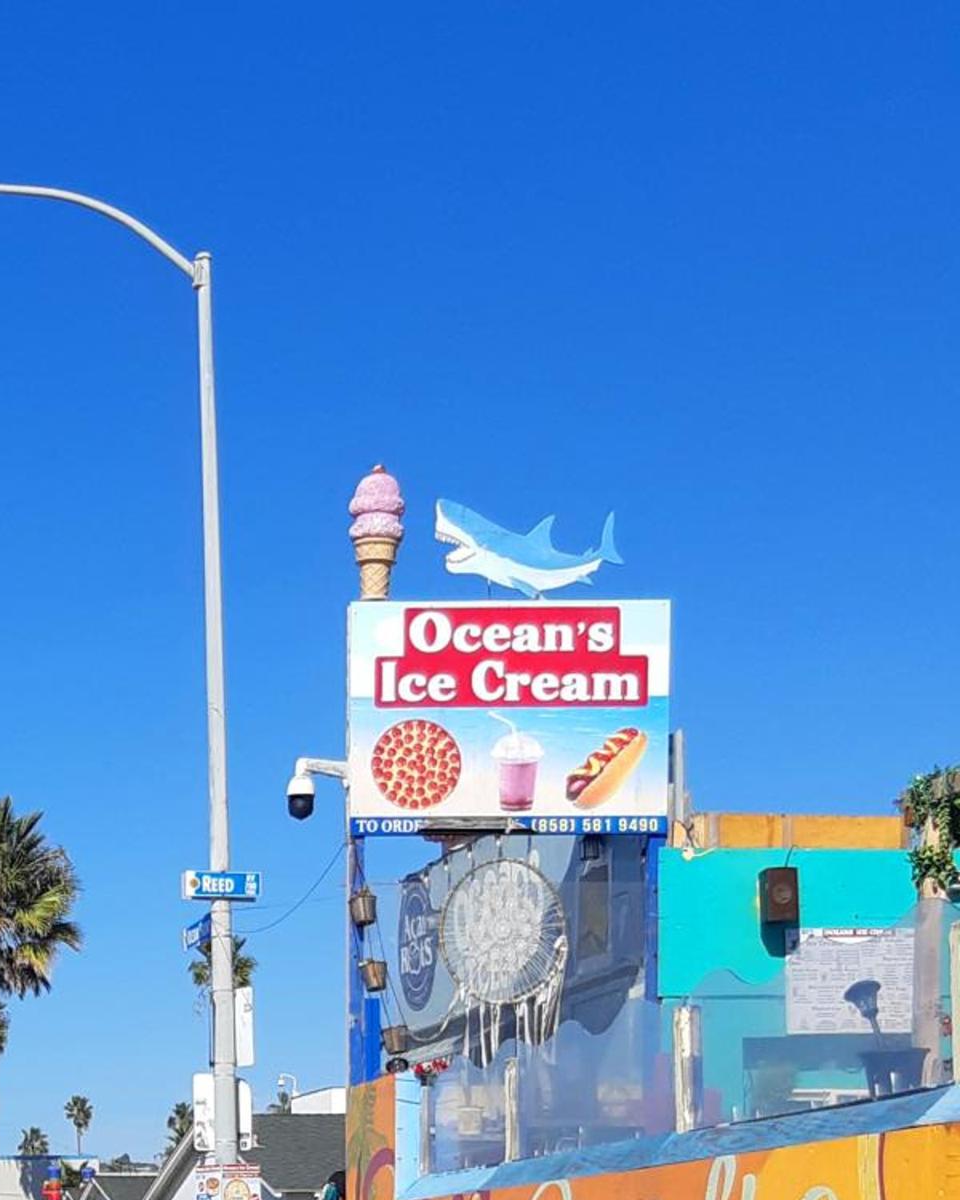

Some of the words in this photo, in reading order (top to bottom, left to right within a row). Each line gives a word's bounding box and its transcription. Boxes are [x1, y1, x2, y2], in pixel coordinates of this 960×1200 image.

[408, 610, 615, 653] Ocean's
[380, 660, 458, 702] Ice
[471, 659, 640, 702] Cream
[355, 819, 379, 833] TO
[531, 818, 576, 833] (858)
[582, 818, 612, 833] 581
[618, 818, 659, 833] 9490
[201, 874, 235, 893] REED
